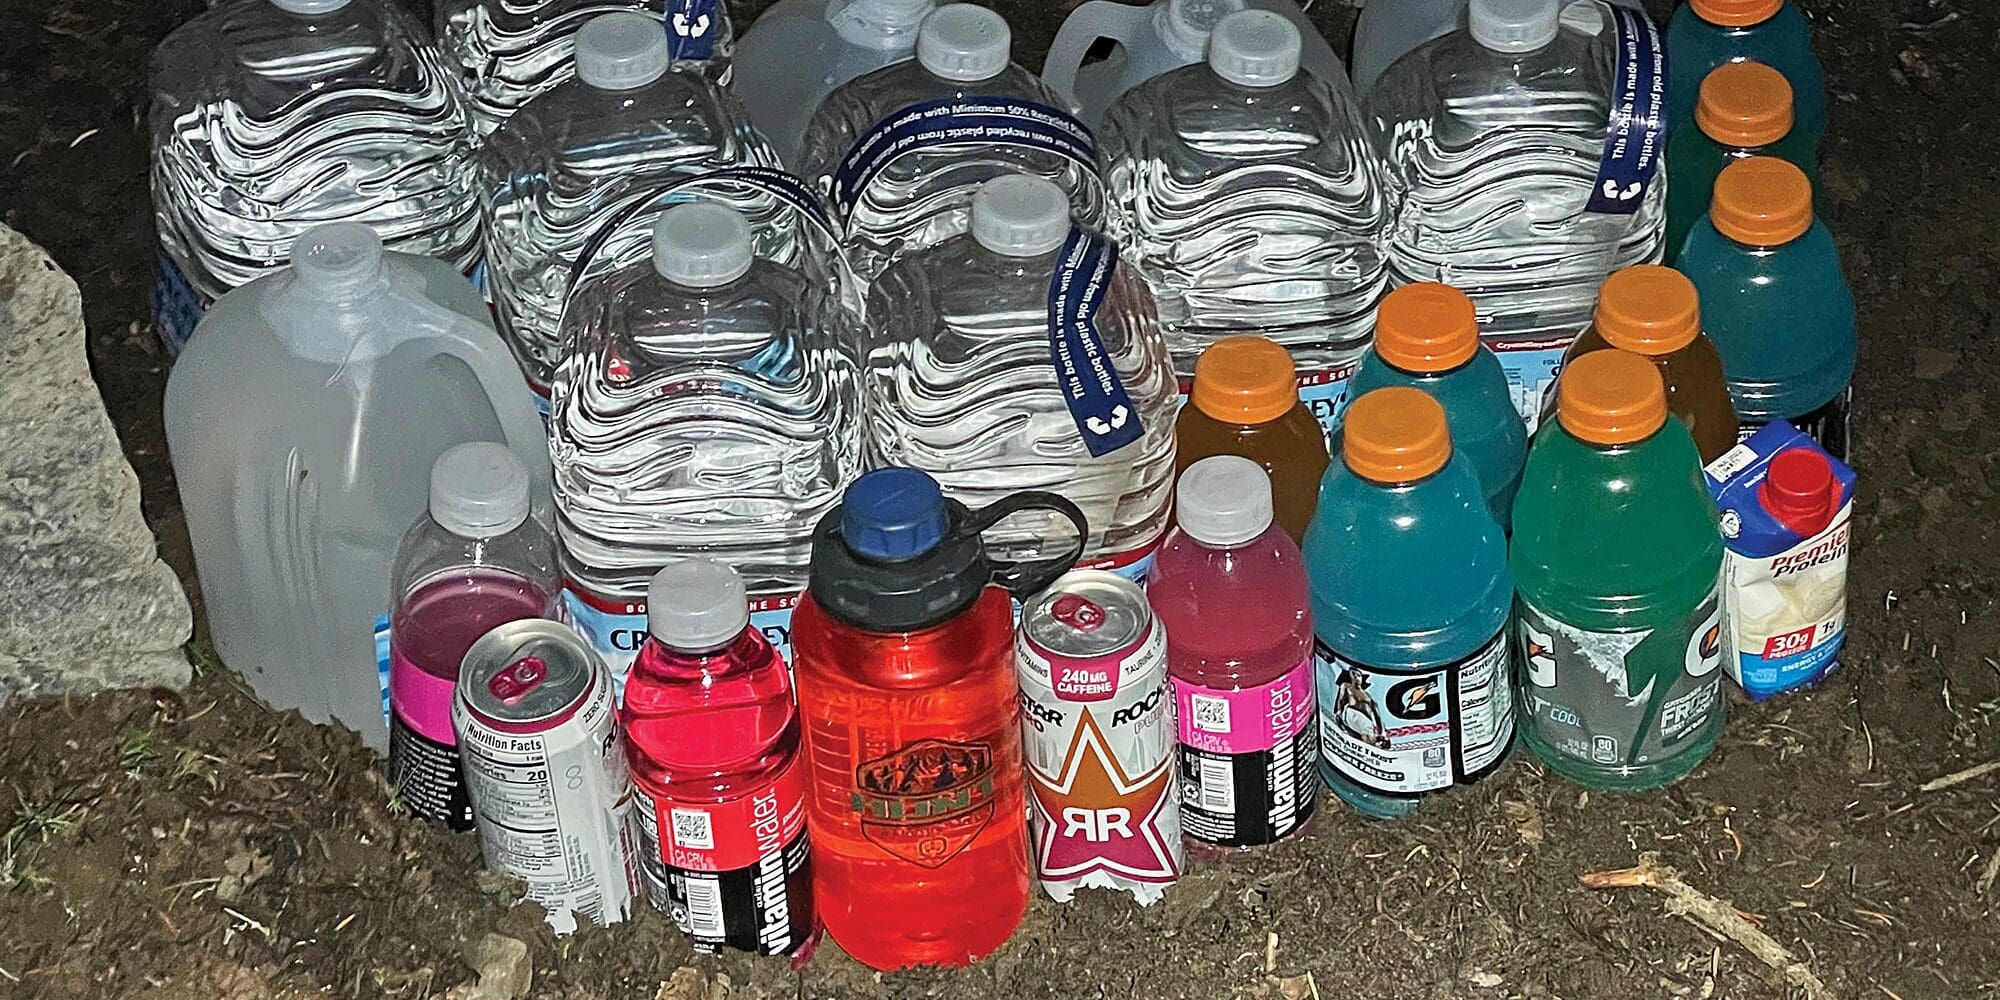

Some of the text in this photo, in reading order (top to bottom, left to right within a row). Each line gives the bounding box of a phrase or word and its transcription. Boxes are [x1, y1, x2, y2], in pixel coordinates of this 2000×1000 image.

[893, 111, 922, 129] made
[1611, 136, 1626, 160] This
[1626, 62, 1638, 90] made
[917, 130, 946, 142] from
[946, 126, 984, 140] plastic
[1055, 293, 1066, 327] made
[1076, 301, 1091, 321] old
[1055, 327, 1065, 339] is
[1075, 321, 1098, 358] plastic
[1058, 341, 1076, 376] bottle
[1091, 356, 1114, 397] bottles.
[1069, 375, 1086, 400] This
[626, 604, 648, 614] BO
[610, 629, 651, 652] CR
[1770, 633, 1810, 653] 30g
[1061, 668, 1108, 684] 240 MG
[1057, 682, 1113, 695] CAFFEINE
[1385, 675, 1441, 720] G
[1550, 708, 1582, 728] COOL
[467, 722, 508, 750] Nutrition
[510, 739, 543, 752] Facts
[526, 769, 548, 782] 20
